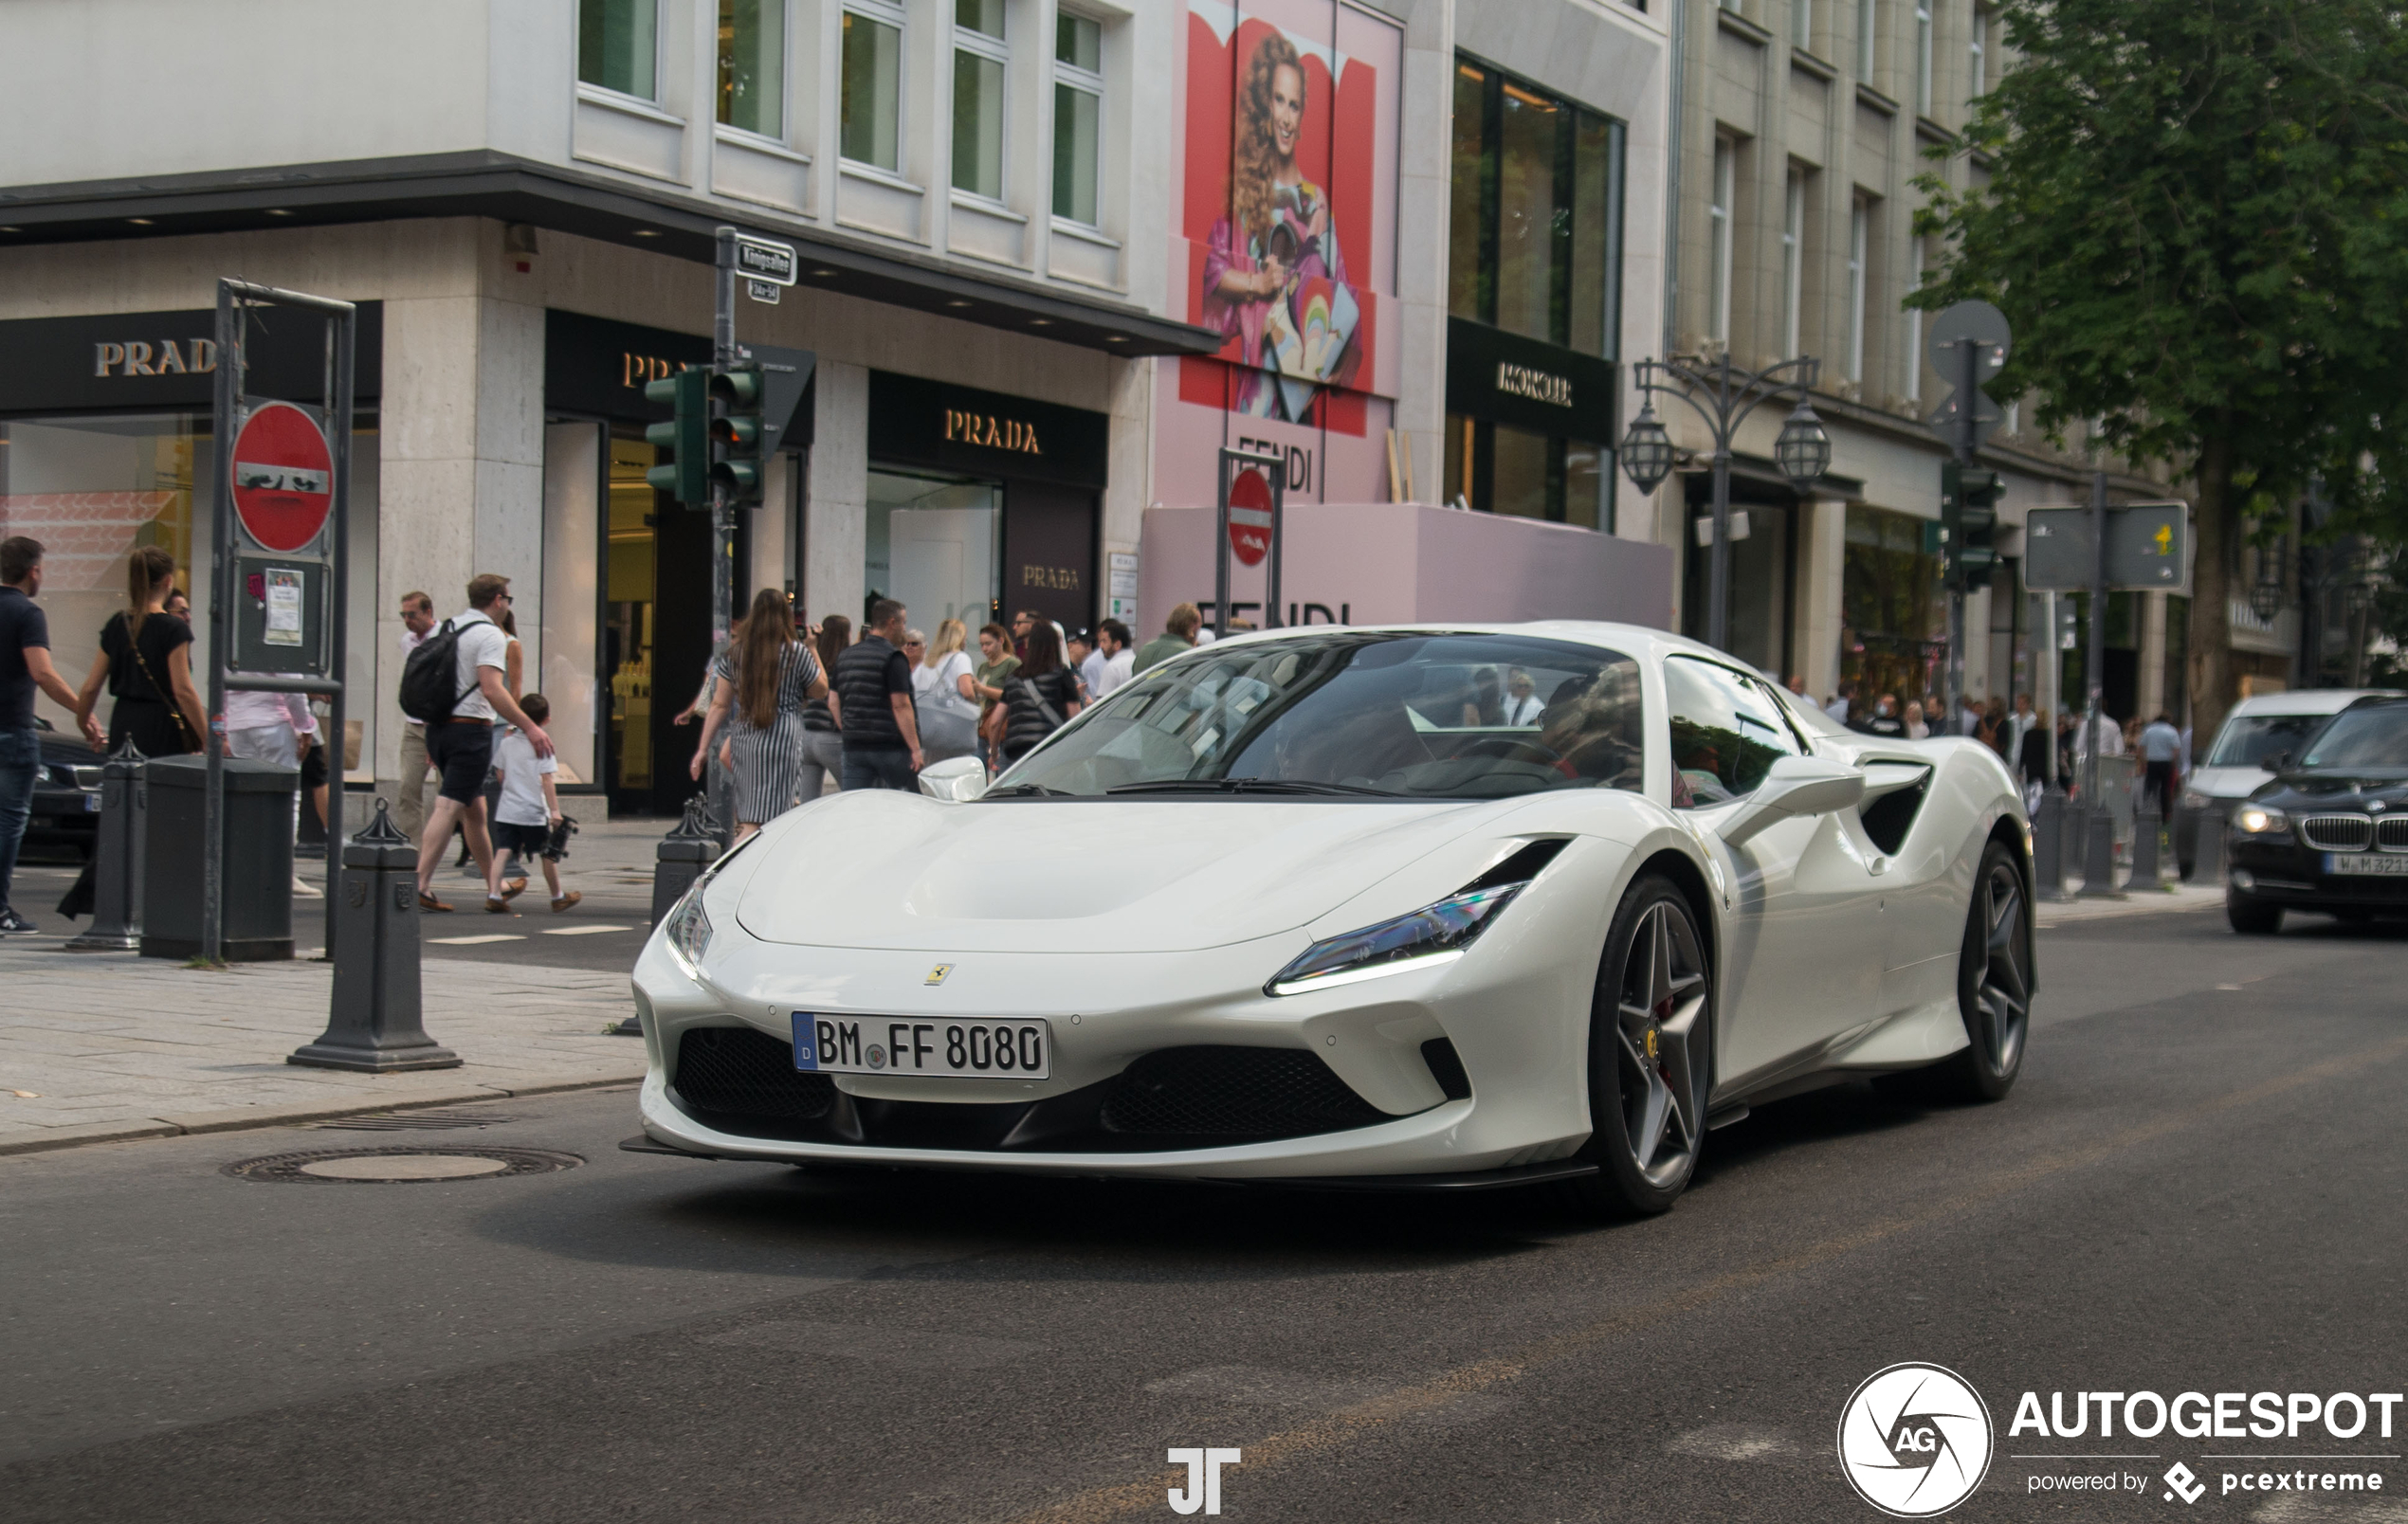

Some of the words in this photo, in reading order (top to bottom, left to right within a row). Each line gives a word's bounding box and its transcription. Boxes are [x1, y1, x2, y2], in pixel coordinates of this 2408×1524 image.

[95, 337, 248, 377] PRAD
[945, 408, 1042, 454] PRADA
[1024, 565, 1080, 590] PRADA
[802, 1046, 812, 1060] D
[816, 1020, 862, 1065] BM
[889, 1023, 934, 1067] FF
[947, 1025, 1042, 1071] 8080
